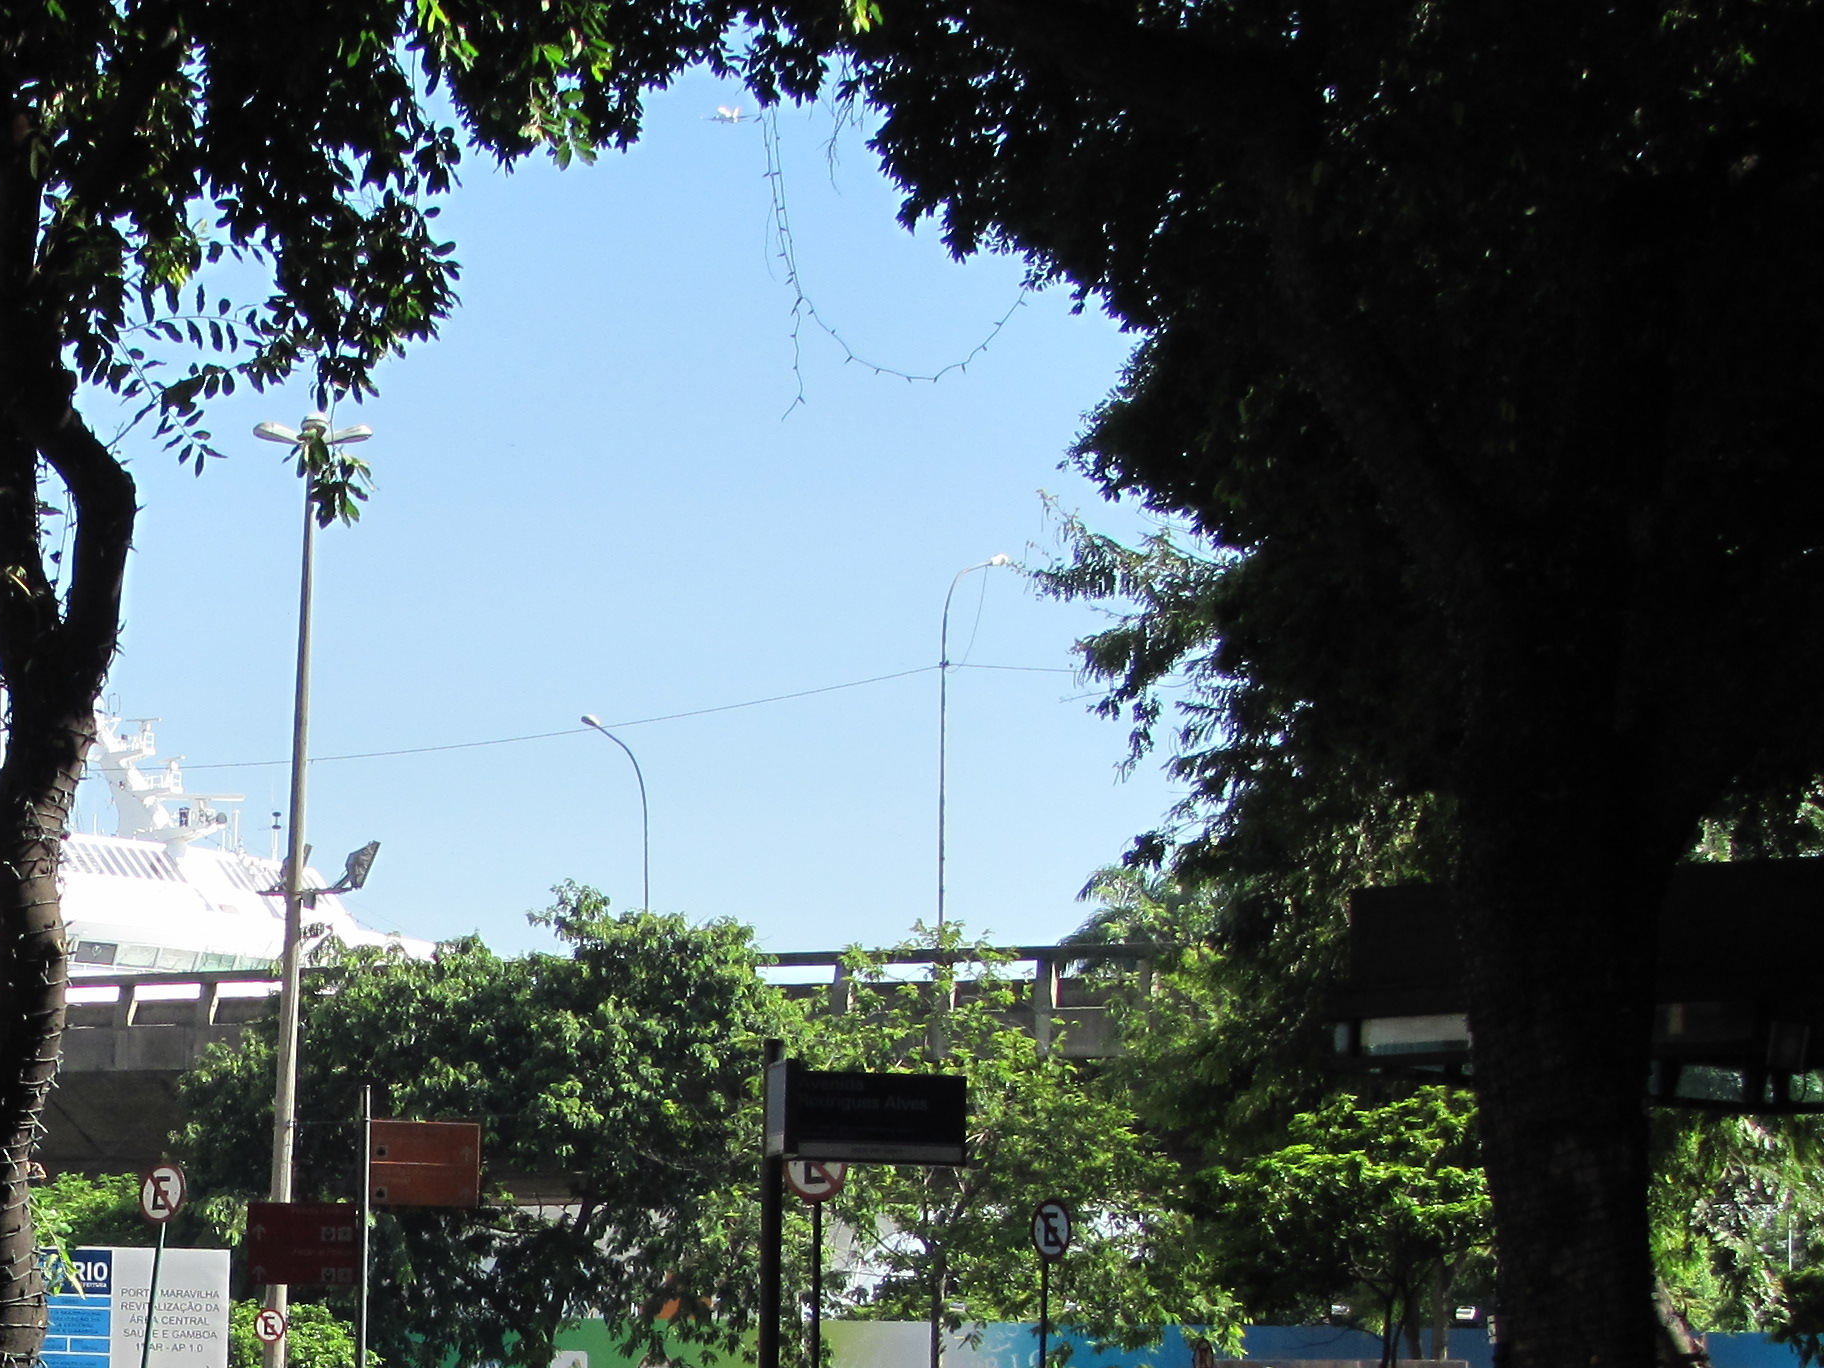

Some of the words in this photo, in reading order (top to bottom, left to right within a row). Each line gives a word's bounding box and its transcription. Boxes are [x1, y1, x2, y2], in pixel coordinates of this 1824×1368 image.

[800, 1076, 864, 1092] Avenida
[800, 1093, 880, 1112] Rodrigues
[884, 1095, 928, 1111] Alves
[74, 1262, 108, 1282] RIO
[121, 1288, 152, 1298] PORT
[160, 1289, 220, 1299] MARAVILHA
[205, 1303, 220, 1312] DA
[161, 1317, 210, 1326] CENTRAL
[163, 1330, 169, 1338] E
[172, 1330, 218, 1340] GAMBOA
[171, 1344, 186, 1352] AP
[189, 1344, 203, 1352] 1.0
